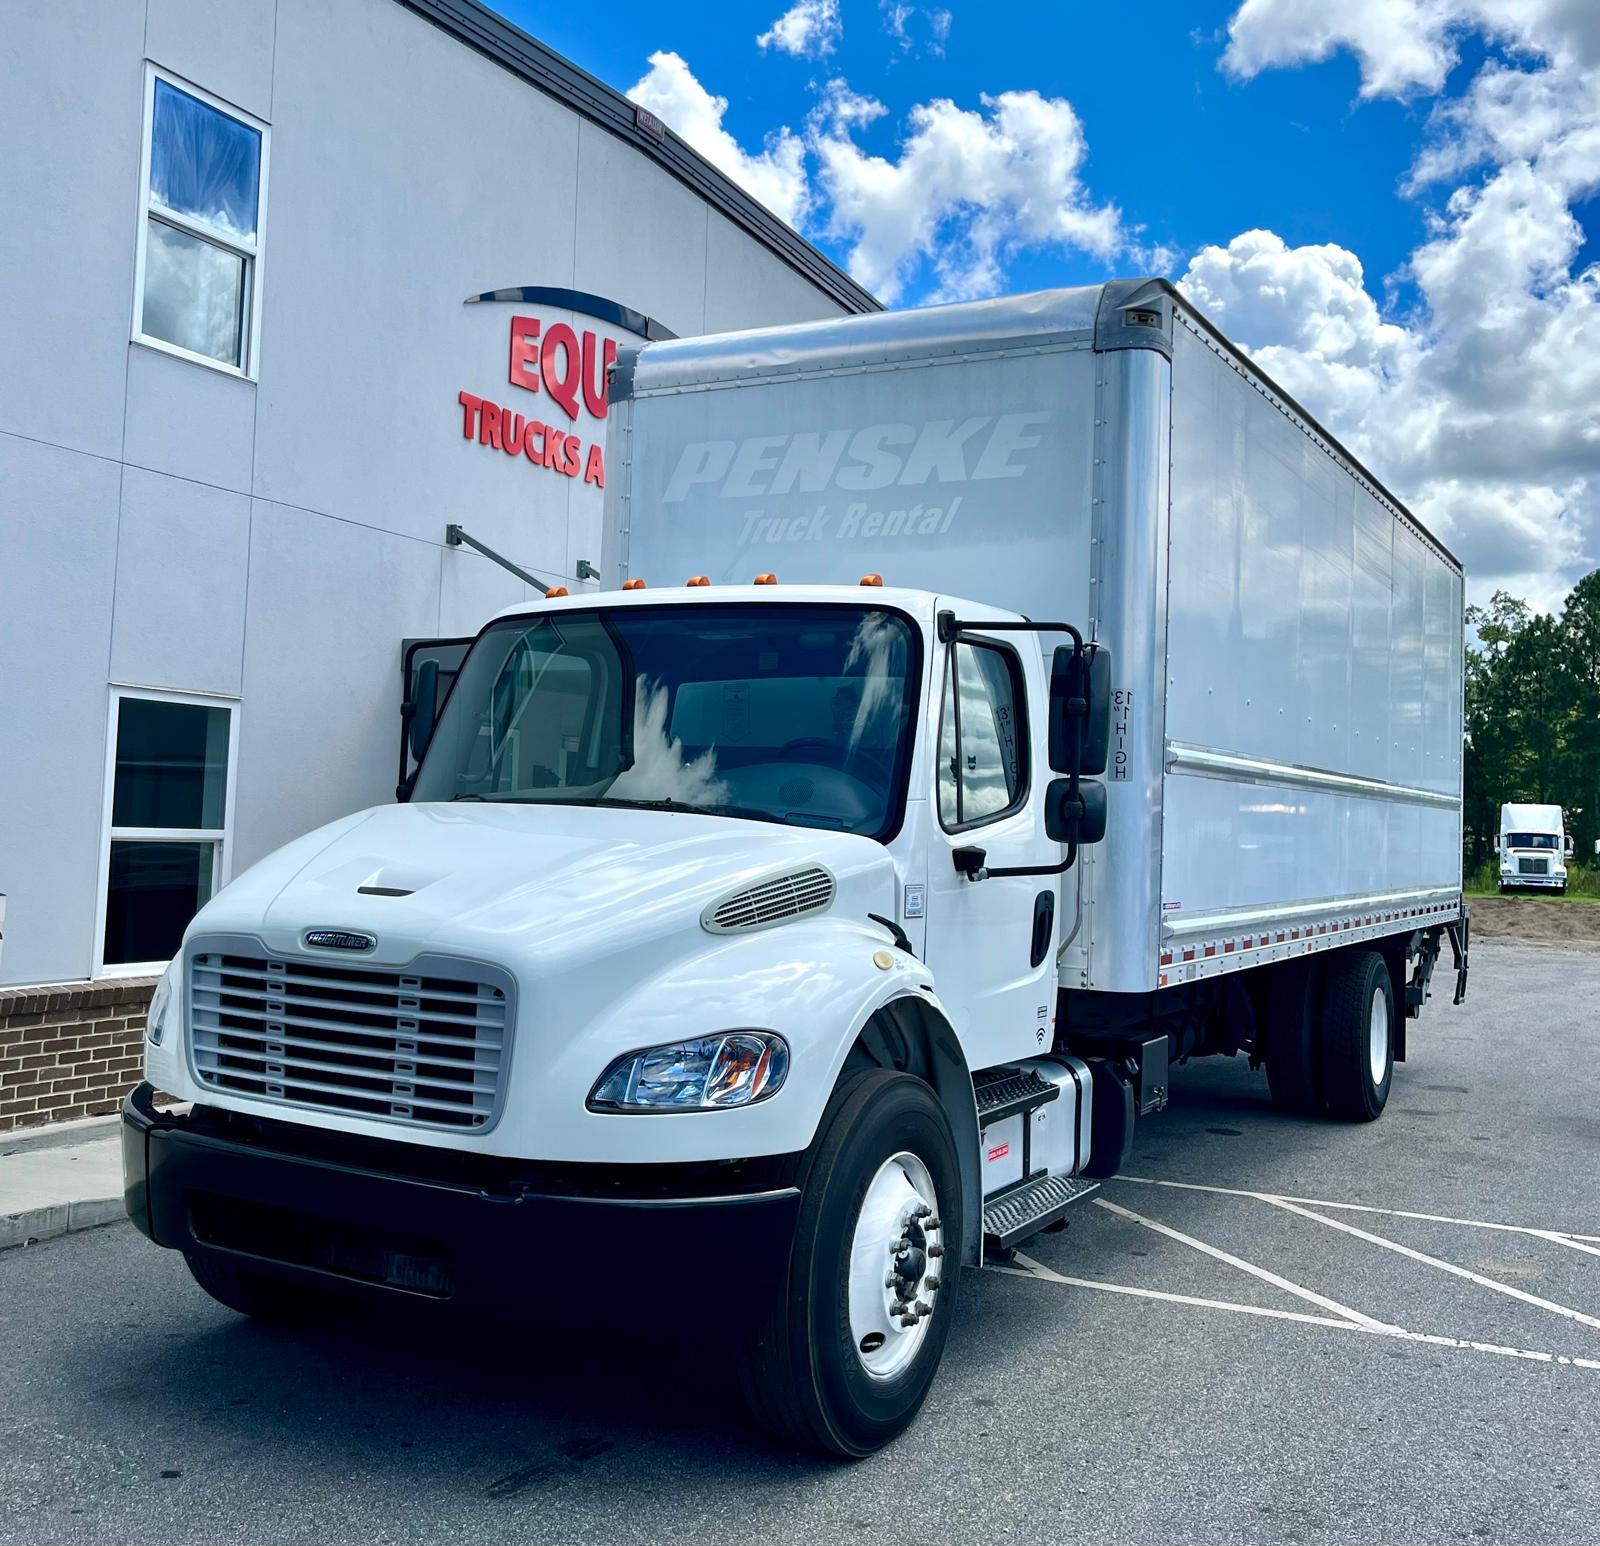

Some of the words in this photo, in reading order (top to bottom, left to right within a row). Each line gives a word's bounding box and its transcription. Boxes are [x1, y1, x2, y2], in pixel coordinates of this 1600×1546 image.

[508, 315, 617, 421] EQU
[459, 390, 581, 478] TRUCKS
[584, 443, 605, 488] A
[662, 410, 1051, 503] PENSKE
[737, 504, 832, 545] Truck
[836, 496, 963, 540] Rental
[308, 932, 367, 948] FREIGHTLINER
